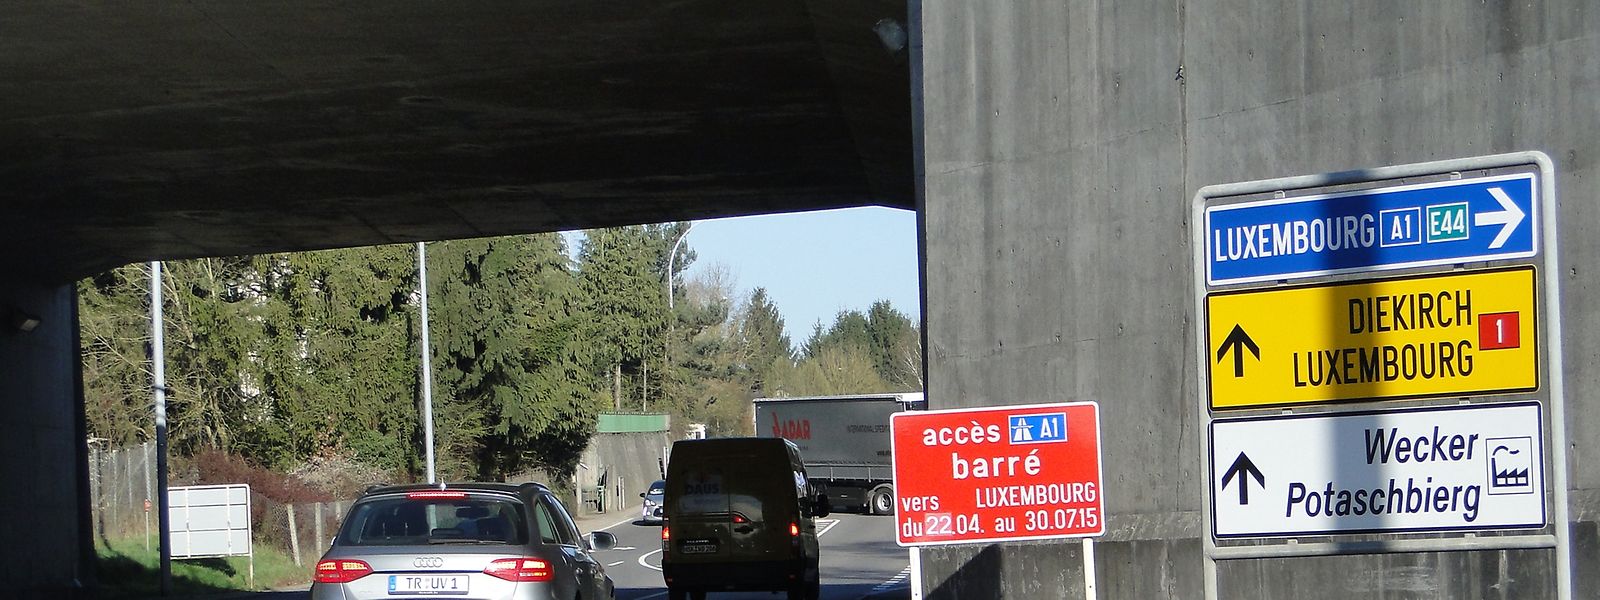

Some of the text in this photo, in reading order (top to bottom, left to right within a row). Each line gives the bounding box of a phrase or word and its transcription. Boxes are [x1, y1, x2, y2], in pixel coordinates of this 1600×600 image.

[1214, 208, 1465, 262] LUXEMBOURG A1 E44
[1348, 289, 1472, 335] DIEKIRCH
[1495, 318, 1504, 345] 1
[1293, 339, 1473, 388] LUXEMBOURG
[922, 417, 1059, 446] accès A1
[1364, 425, 1479, 465] Wecker
[951, 448, 1042, 479] barré
[901, 481, 1097, 512] vers LUXEMBOURG
[1286, 476, 1481, 523] Potaschbierg
[902, 517, 923, 538] du
[994, 517, 1016, 533] au
[1025, 507, 1098, 531] 30.07.15
[405, 577, 459, 589] TR UV 1
